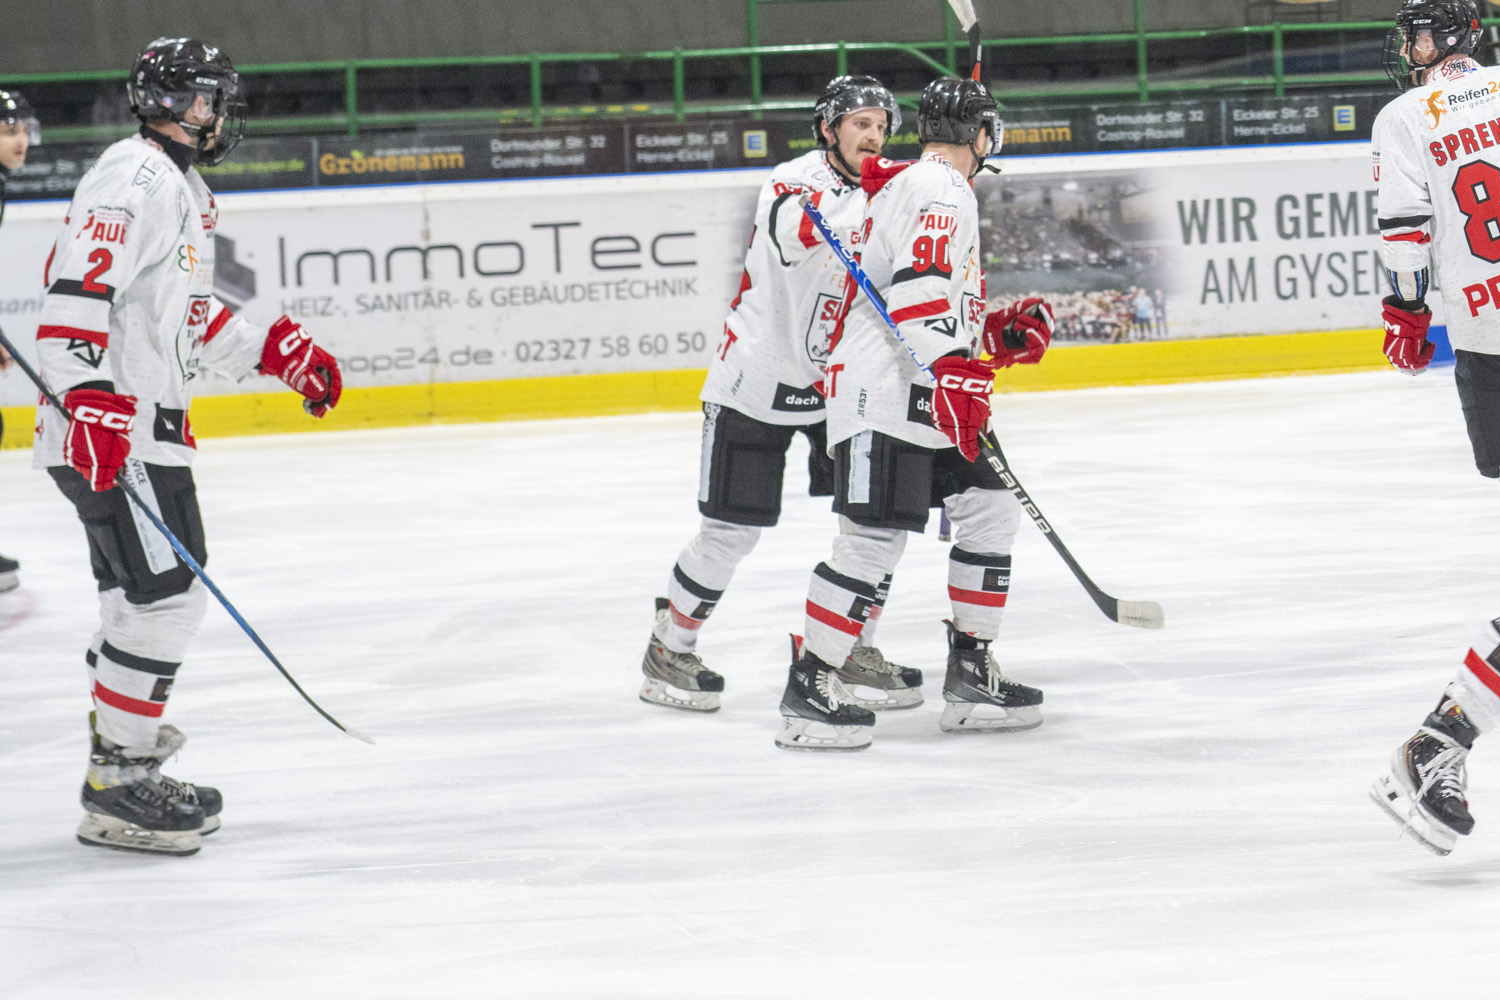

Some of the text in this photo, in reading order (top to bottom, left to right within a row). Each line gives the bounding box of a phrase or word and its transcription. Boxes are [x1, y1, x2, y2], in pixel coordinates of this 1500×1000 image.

[1451, 103, 1466, 113] Wir
[1469, 95, 1497, 109] geben
[1177, 197, 1258, 246] WIR
[82, 247, 114, 295] 2
[279, 220, 698, 288] ImmoTec
[912, 234, 953, 274] 90
[355, 283, 459, 317] SANITÄR-
[467, 287, 485, 310] &
[491, 275, 699, 308] GEBÄUDETECHNIK
[1200, 257, 1258, 305] AM
[516, 338, 591, 366] 02327
[601, 334, 631, 359] 58
[639, 332, 669, 357] 60
[676, 330, 707, 354] 50
[784, 392, 820, 406] dach
